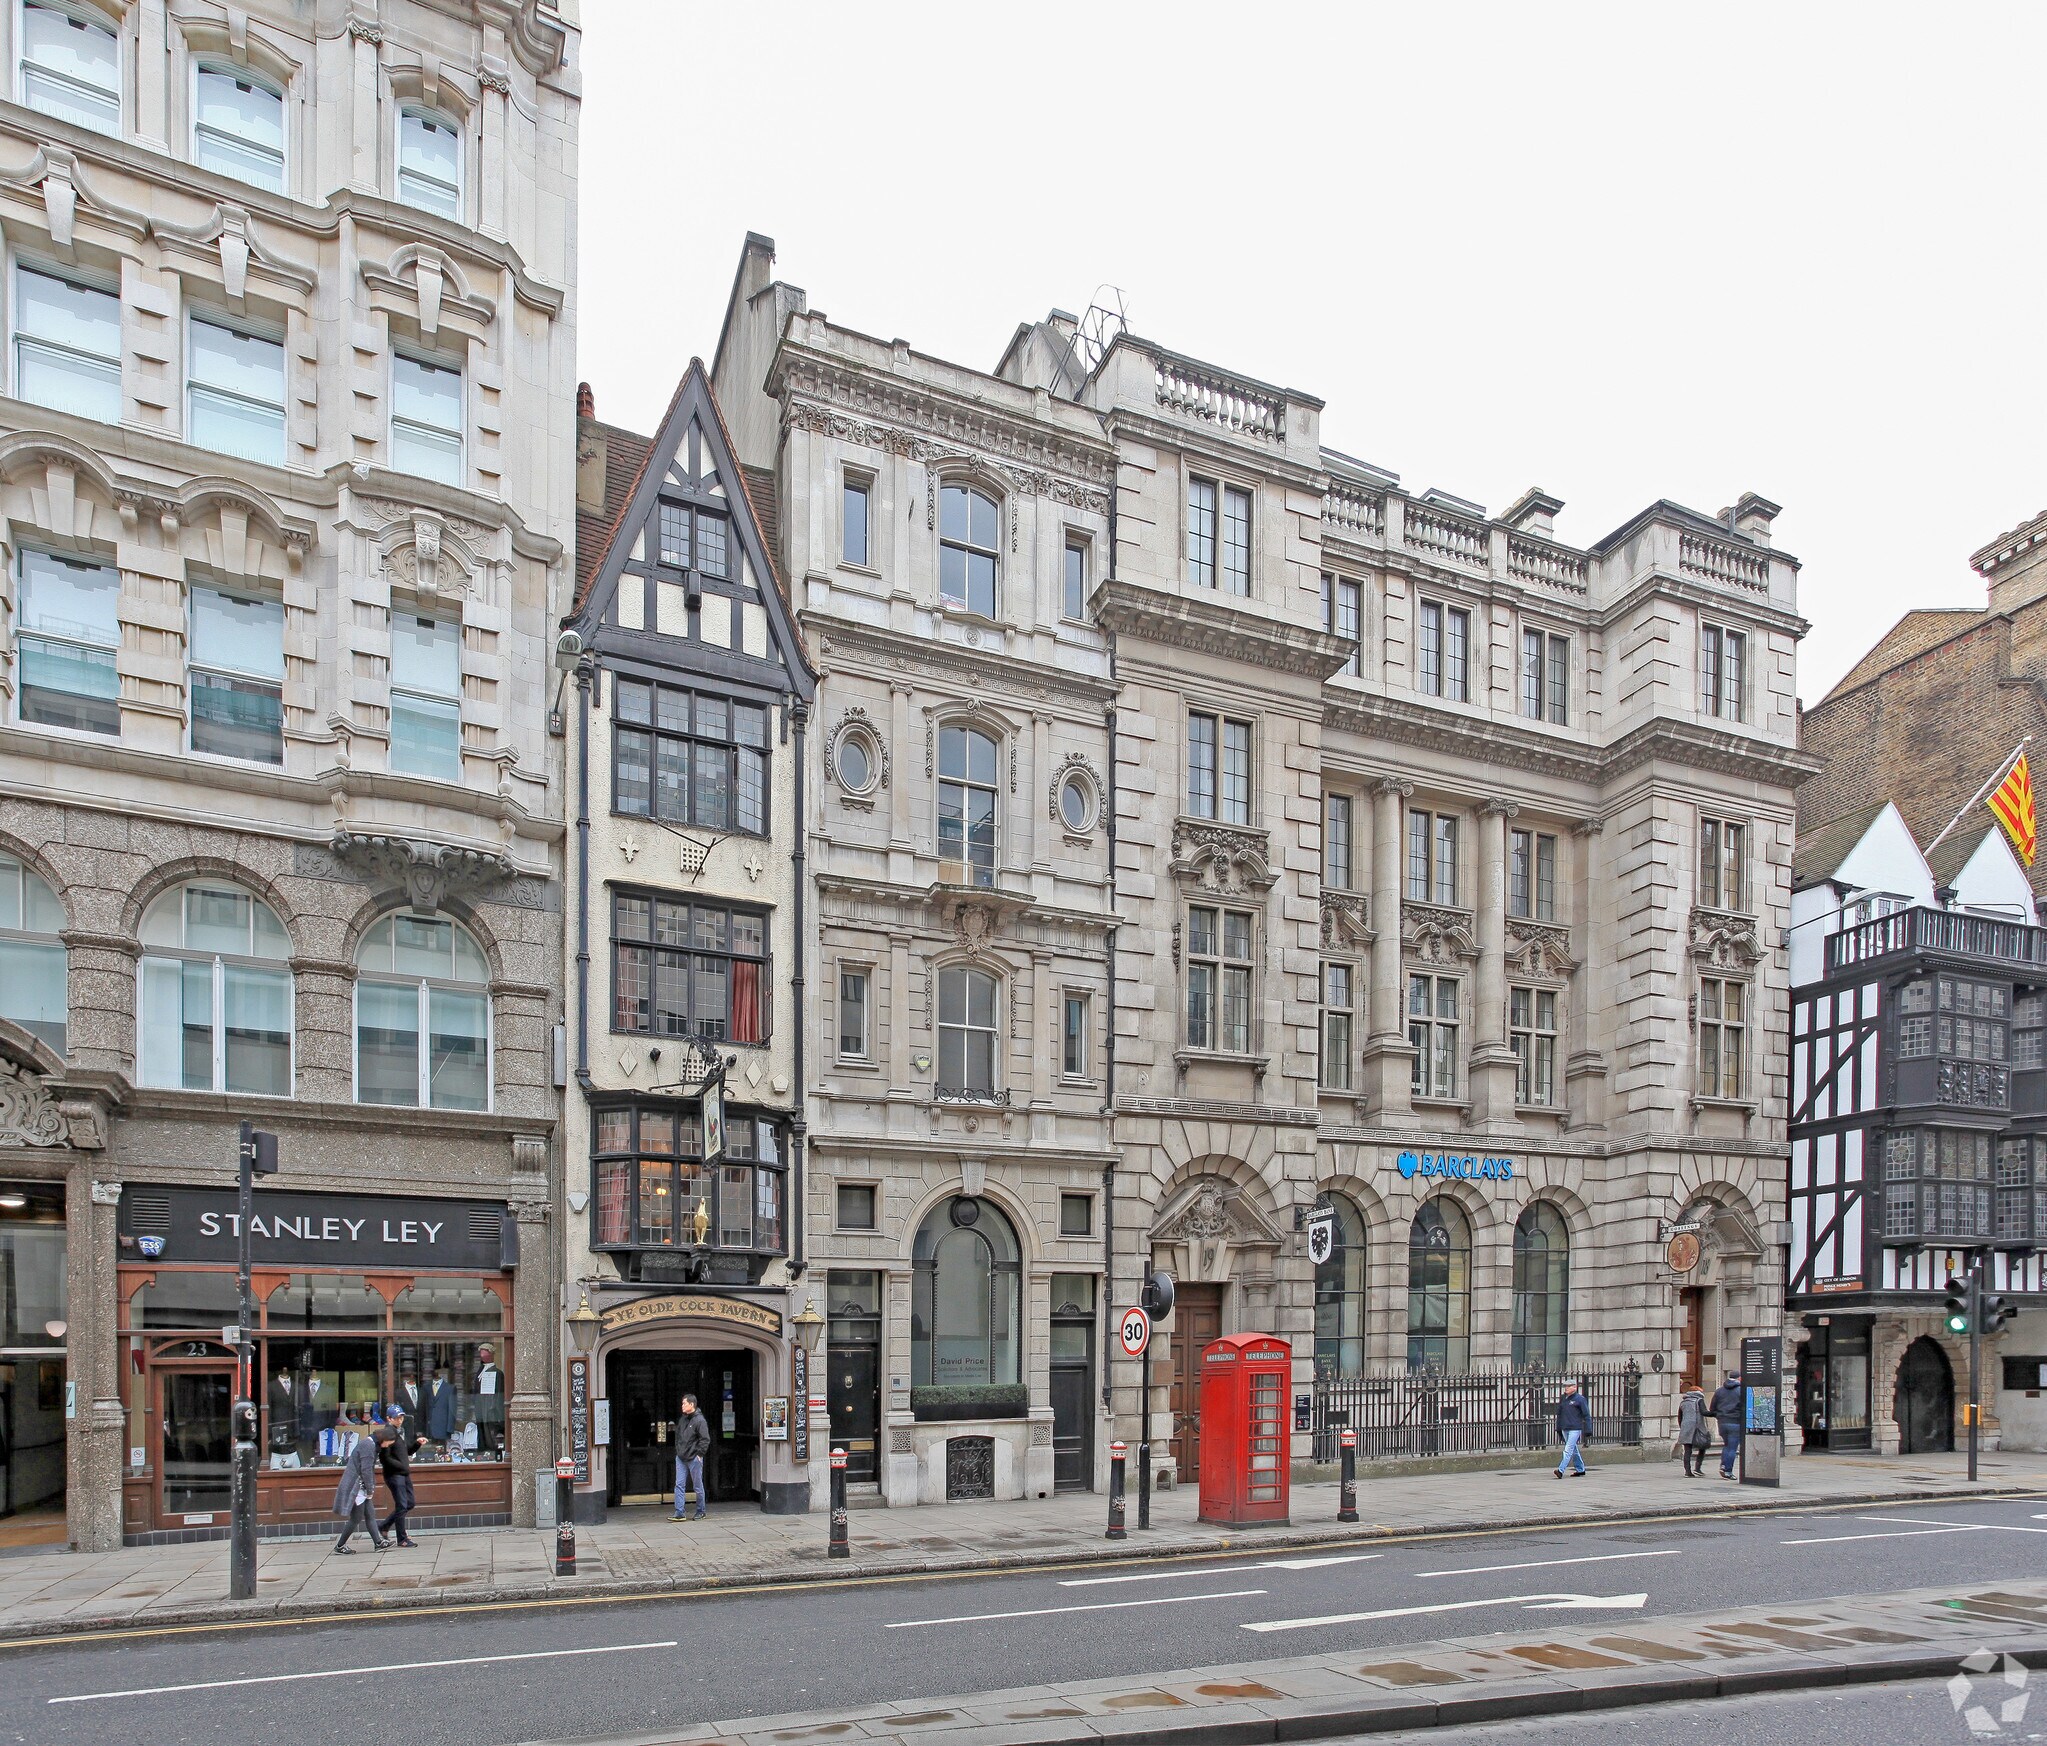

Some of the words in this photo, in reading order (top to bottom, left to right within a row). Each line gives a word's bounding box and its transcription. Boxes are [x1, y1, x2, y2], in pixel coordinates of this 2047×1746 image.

[1421, 1154, 1513, 1180] BARCLAYS
[200, 1212, 367, 1241] STANLEY
[383, 1219, 443, 1243] LEY
[142, 1241, 160, 1249] ESS
[1203, 1247, 1215, 1272] 19
[616, 1308, 635, 1322] YE
[639, 1302, 675, 1315] OLDE
[679, 1301, 715, 1312] COCK
[719, 1303, 768, 1324] TAVERN
[1125, 1322, 1143, 1341] 30
[187, 1343, 207, 1356] 23
[1208, 1353, 1235, 1361] TELEPHONE
[1247, 1352, 1284, 1360] TELEPHONE
